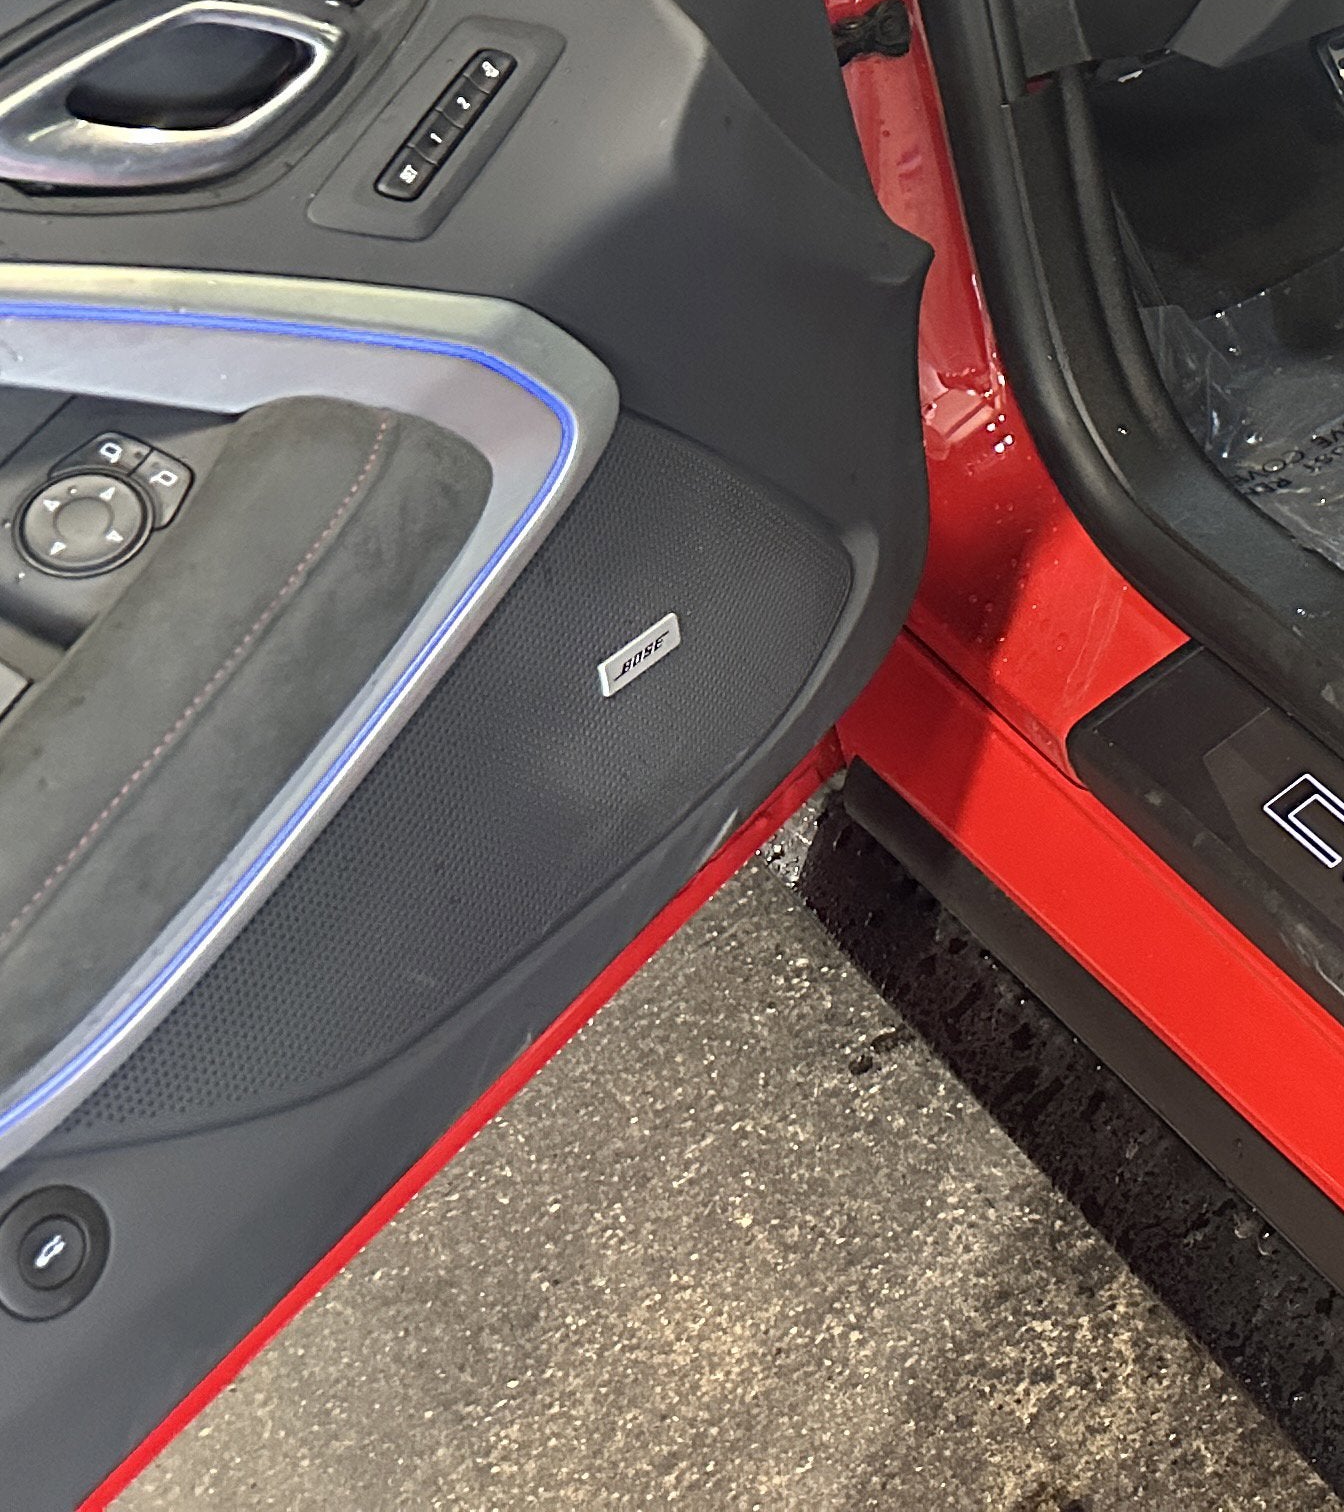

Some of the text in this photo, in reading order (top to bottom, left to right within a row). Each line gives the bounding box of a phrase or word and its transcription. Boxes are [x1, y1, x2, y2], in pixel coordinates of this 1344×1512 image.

[456, 96, 471, 110] 2
[430, 132, 443, 144] 1
[615, 632, 668, 680] BOSE
